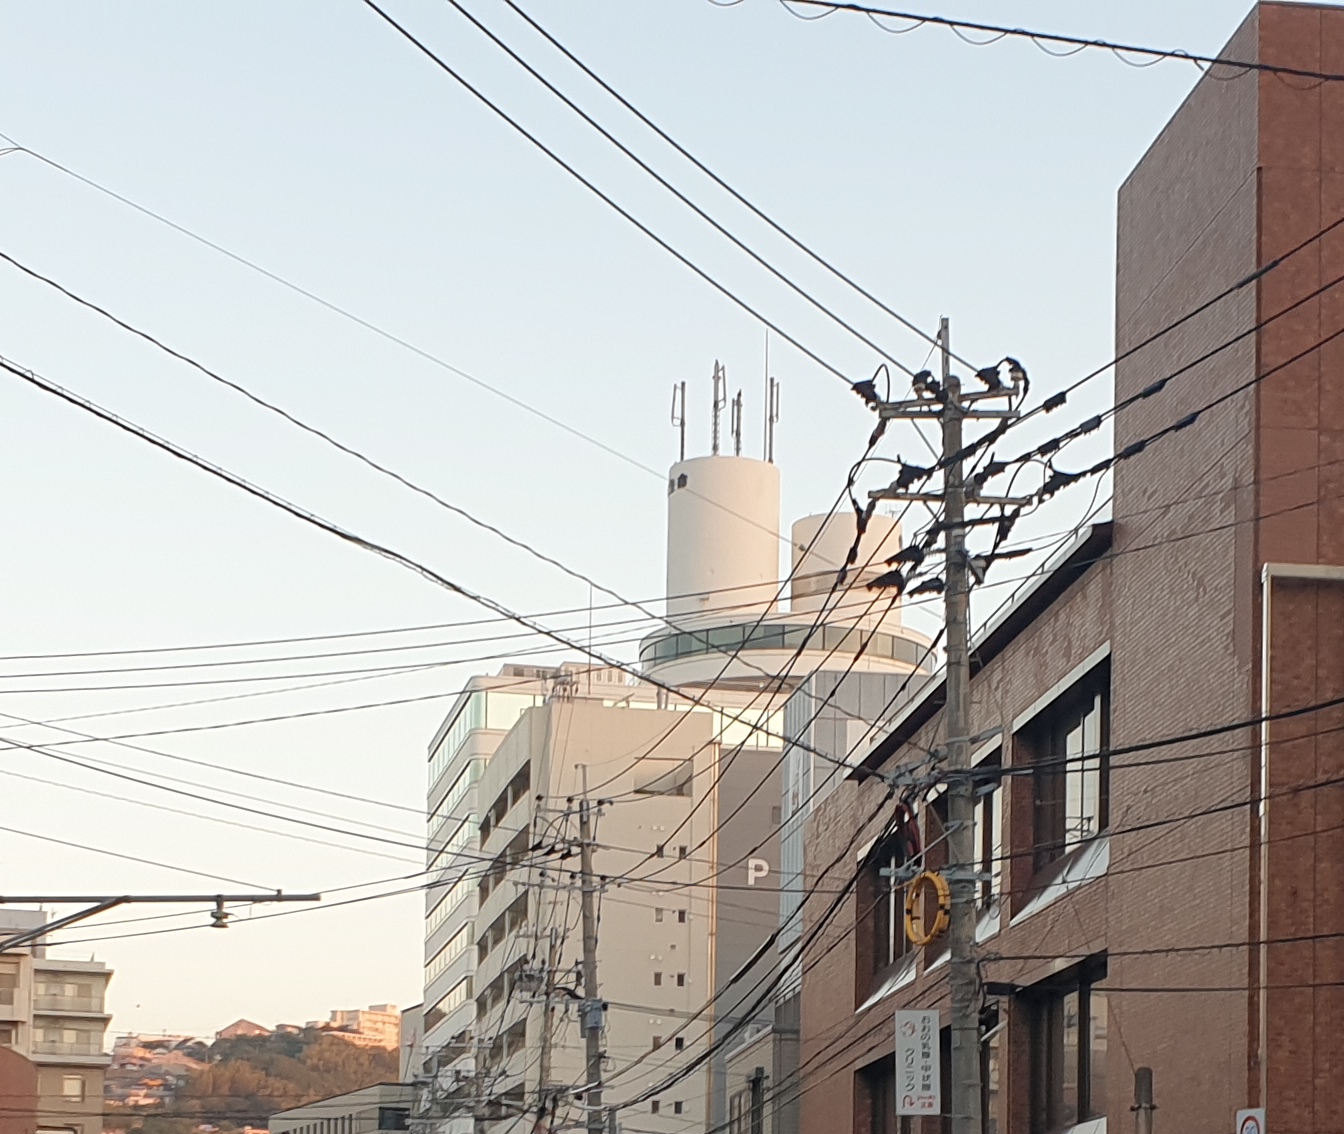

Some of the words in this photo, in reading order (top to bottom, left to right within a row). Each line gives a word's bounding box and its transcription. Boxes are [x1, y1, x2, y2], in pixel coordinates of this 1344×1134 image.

[748, 858, 769, 886] P
[904, 1047, 916, 1092] クリニック
